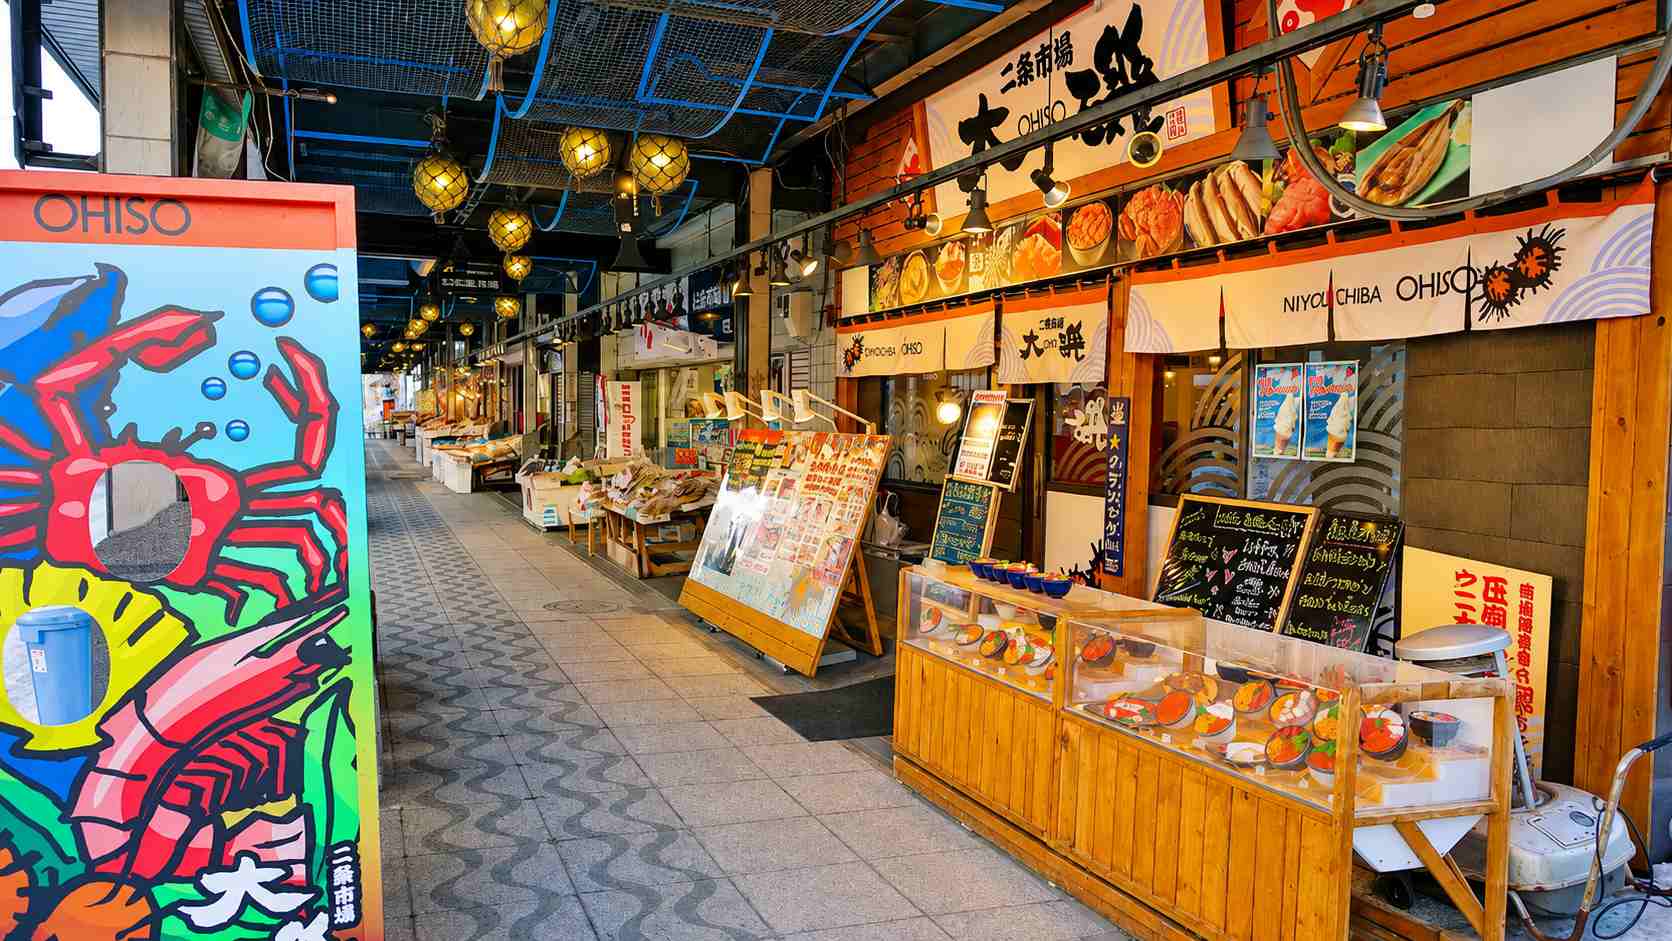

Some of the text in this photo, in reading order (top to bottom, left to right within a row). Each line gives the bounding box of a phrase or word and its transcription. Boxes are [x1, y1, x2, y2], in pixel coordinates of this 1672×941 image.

[1000, 31, 1074, 94] 二条市場
[1018, 100, 1067, 137] OHISO
[33, 193, 192, 236] OHISO
[1396, 266, 1477, 301] OHISO
